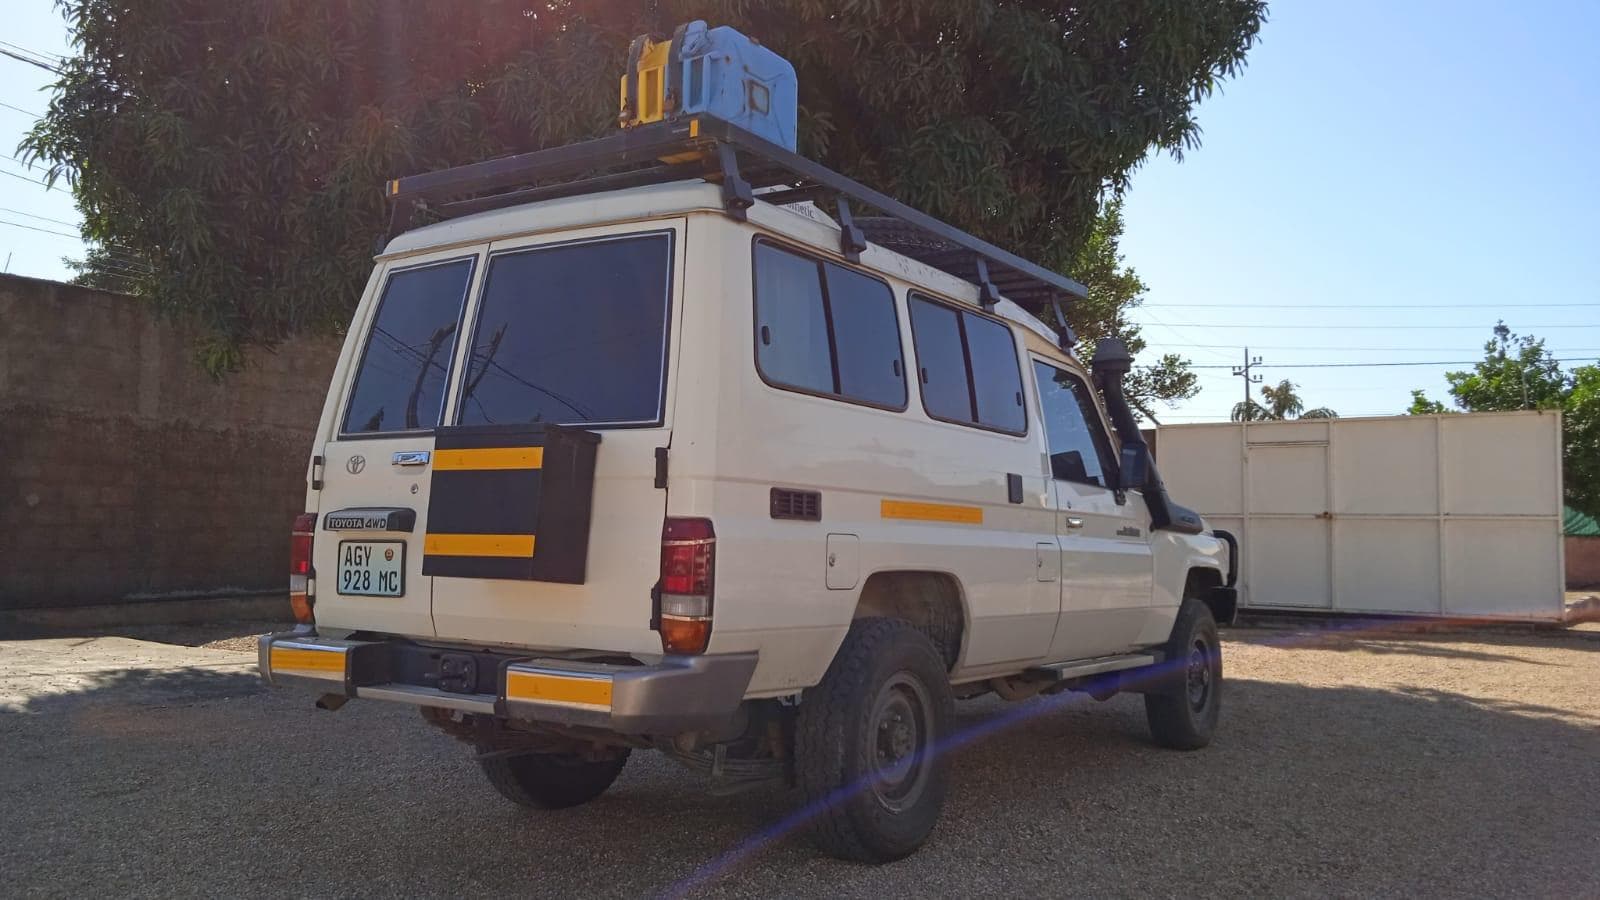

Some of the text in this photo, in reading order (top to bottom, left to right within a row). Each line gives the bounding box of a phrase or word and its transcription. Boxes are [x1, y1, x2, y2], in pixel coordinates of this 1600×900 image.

[330, 518, 386, 528] TOYOTA 4WD
[344, 546, 372, 567] AGY
[343, 570, 398, 592] 928 MC
